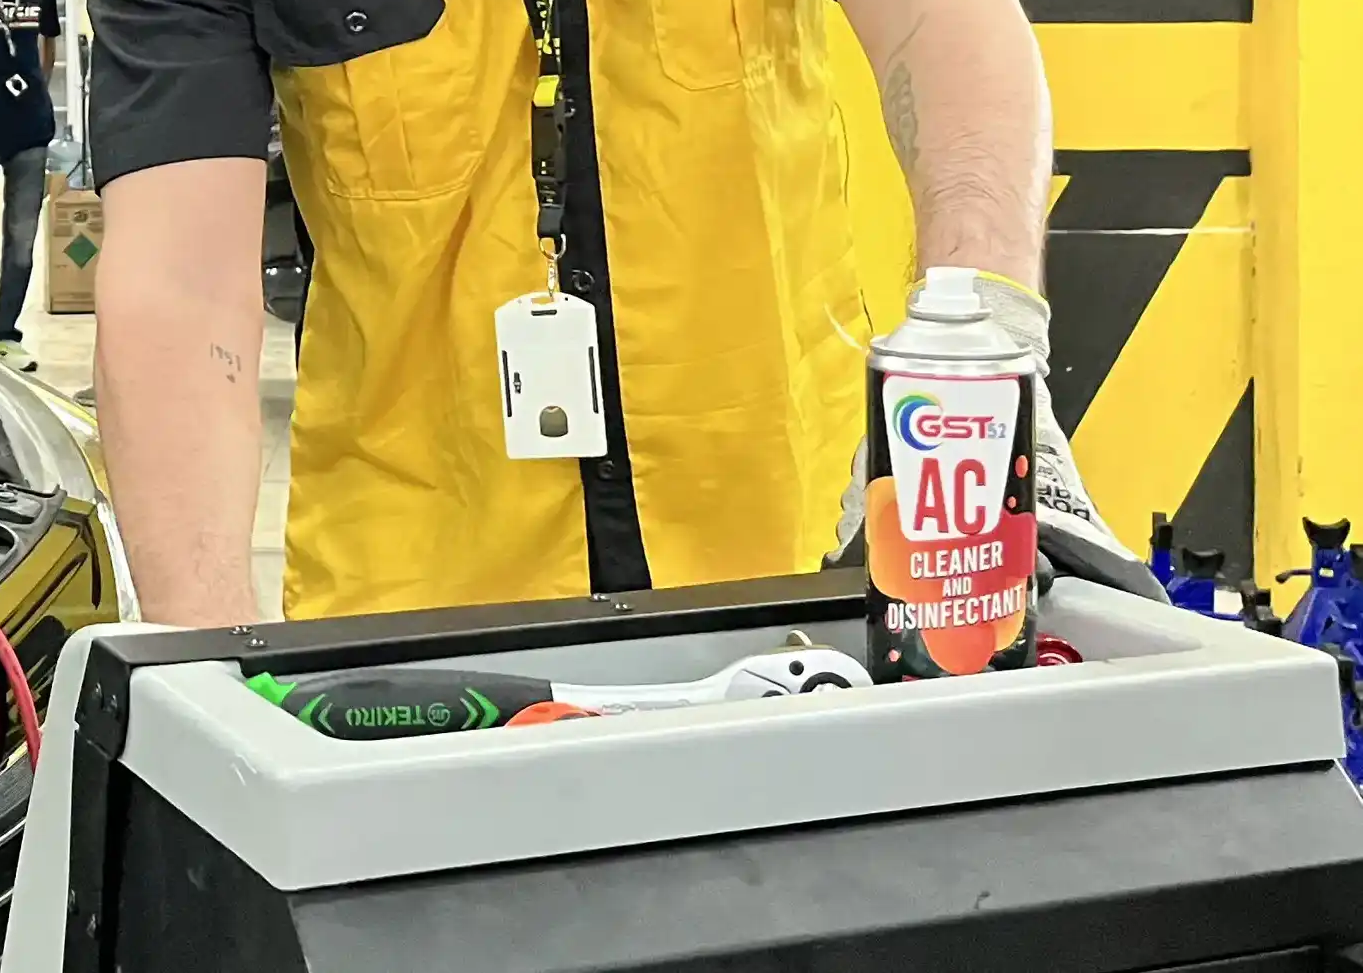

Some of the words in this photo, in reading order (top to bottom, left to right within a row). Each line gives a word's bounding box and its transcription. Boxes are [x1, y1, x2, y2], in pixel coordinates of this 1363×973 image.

[917, 414, 994, 439] GST
[913, 457, 986, 536] AC
[910, 541, 1003, 578] CLEANER
[942, 577, 973, 597] AND
[887, 584, 1025, 630] DISINFECTANT
[345, 705, 426, 727] TEKIRO
